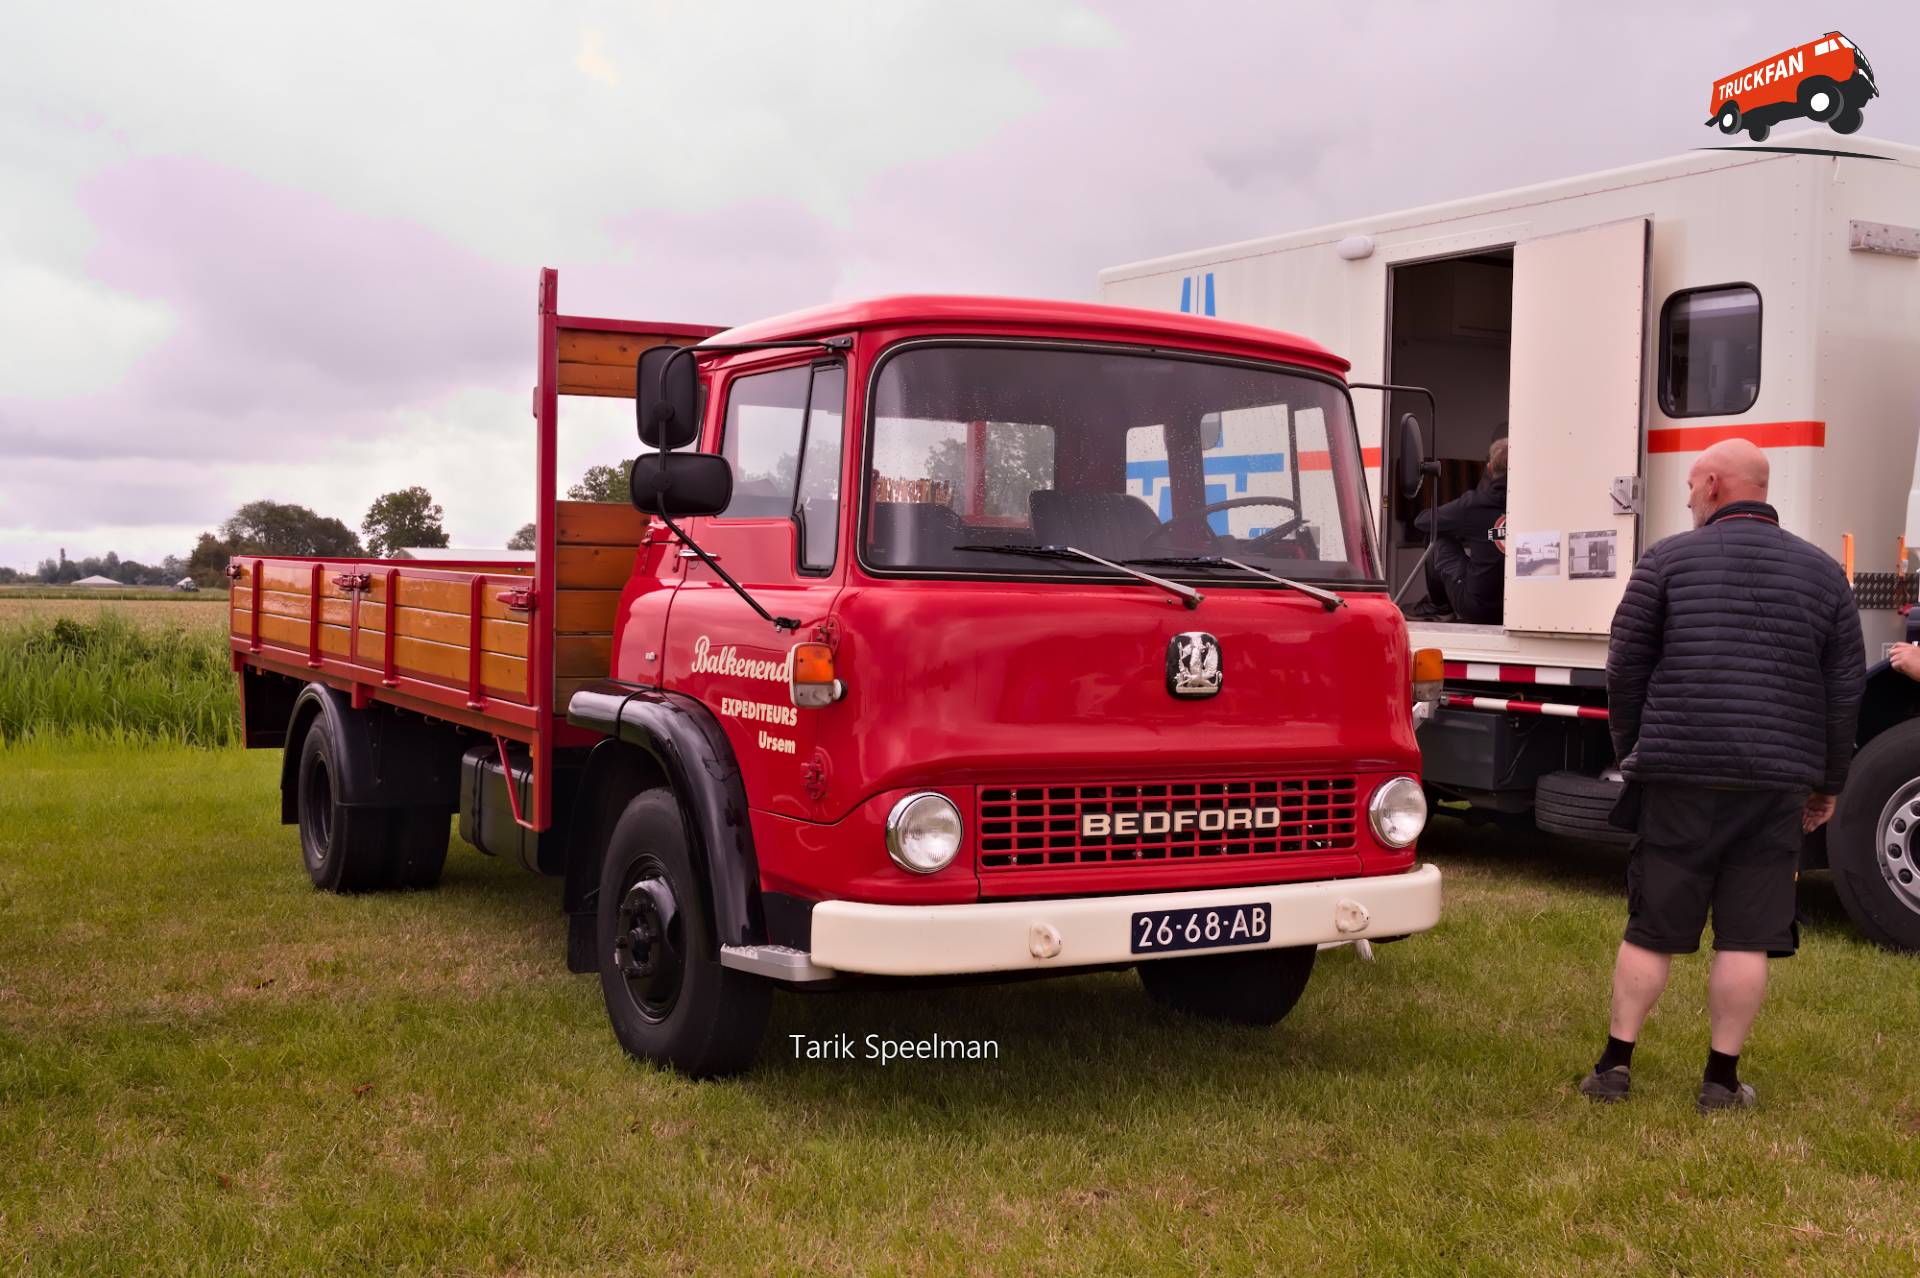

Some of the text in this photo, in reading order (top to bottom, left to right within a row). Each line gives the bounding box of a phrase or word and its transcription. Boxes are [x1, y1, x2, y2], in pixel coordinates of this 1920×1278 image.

[721, 697, 798, 727] EXPEDITEURS
[758, 730, 796, 754] Ursem
[1082, 807, 1281, 837] BEDFORD
[1138, 907, 1267, 947] 26-68-AB
